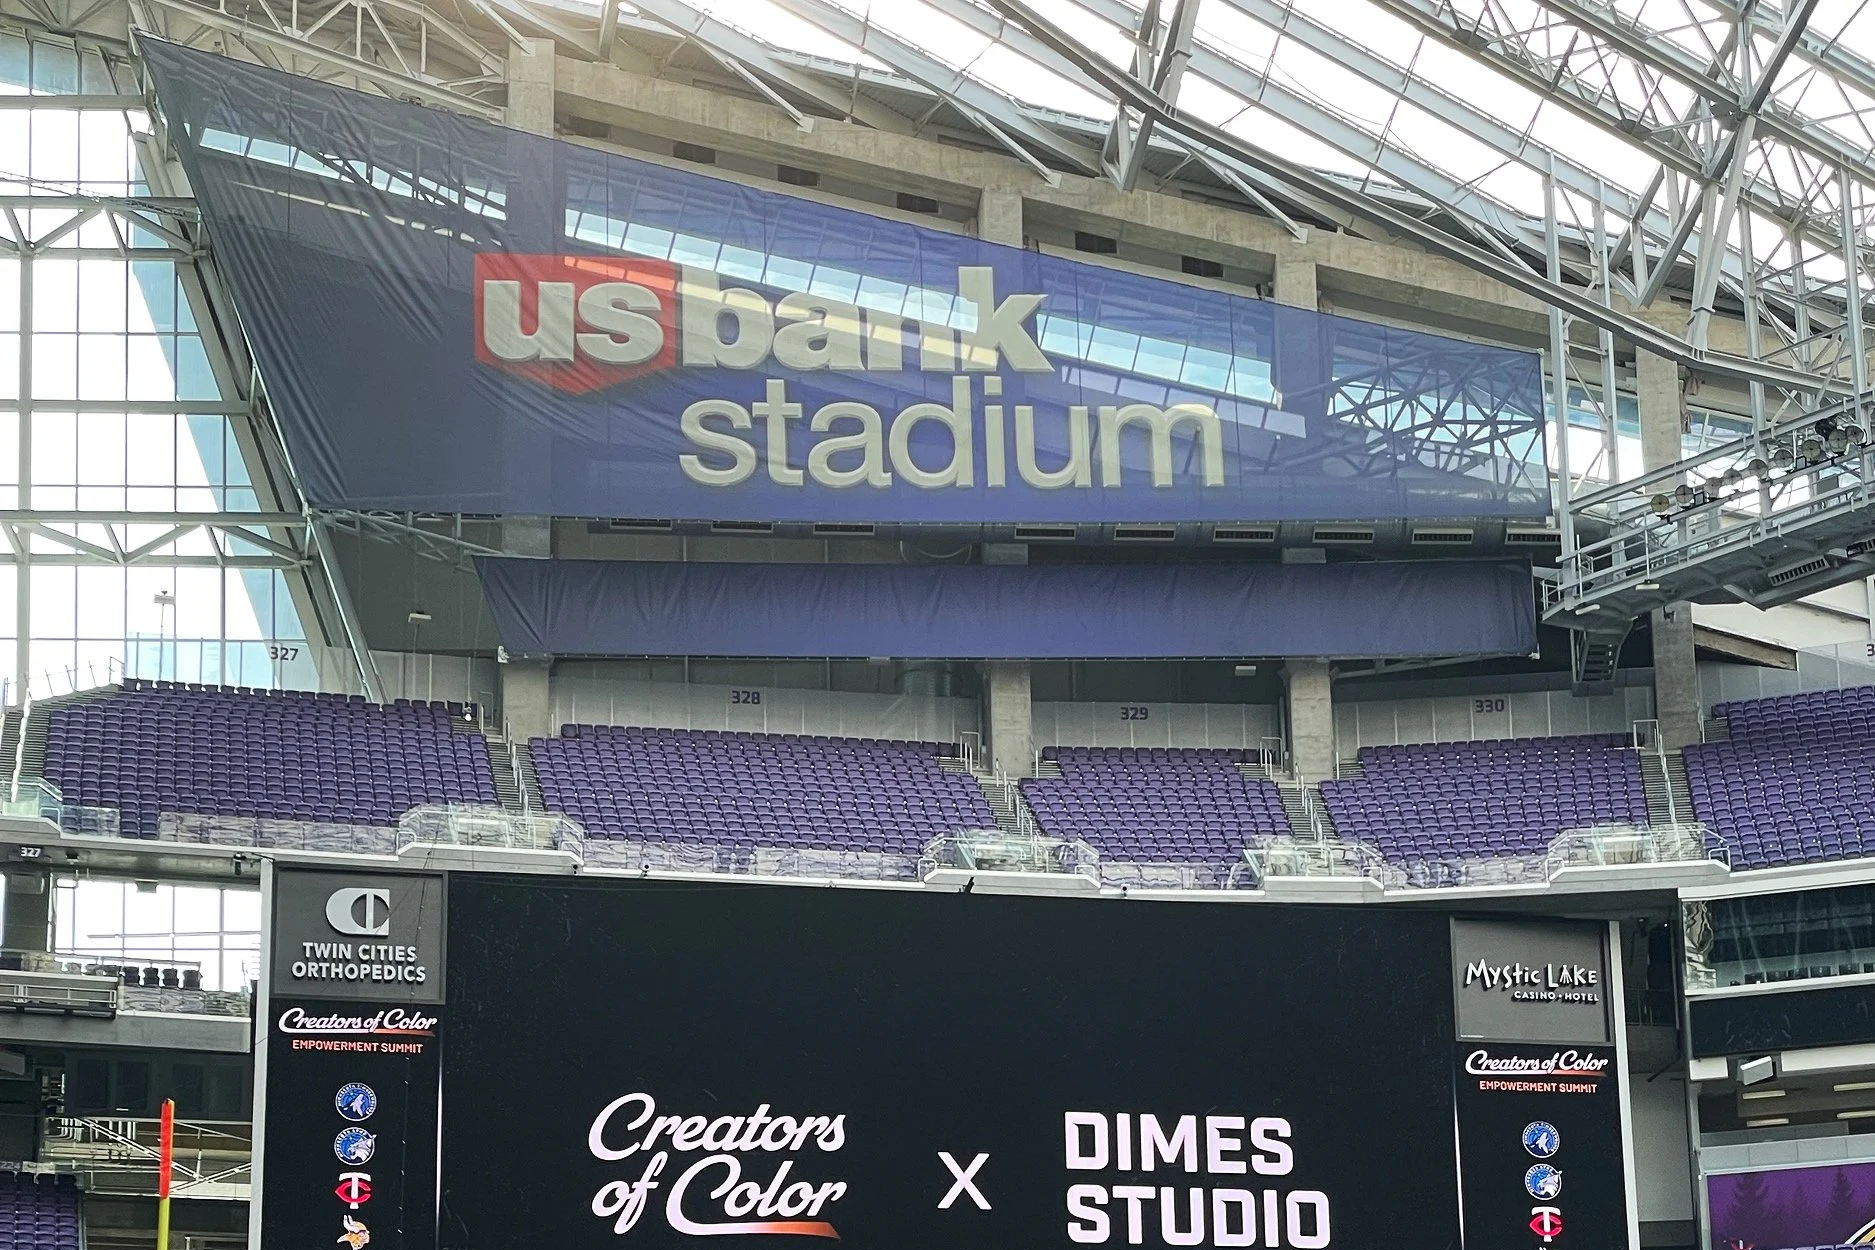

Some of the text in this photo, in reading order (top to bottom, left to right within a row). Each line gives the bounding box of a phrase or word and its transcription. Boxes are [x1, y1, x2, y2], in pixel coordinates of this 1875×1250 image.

[678, 375, 1226, 489] stadium
[269, 646, 299, 662] 327
[731, 690, 761, 705] 328
[1474, 699, 1505, 714] 330
[1119, 706, 1149, 721] 329
[20, 846, 41, 858] 327
[302, 942, 418, 962] TWIN CITIES
[291, 961, 426, 983] ORTHOPEDICS
[1513, 990, 1600, 1001] CASINO HOTEL
[278, 1007, 438, 1034] Creators of Color
[292, 1039, 424, 1054] EMPOWERMENT SUMMIT
[1465, 1050, 1609, 1075] Creators of Color
[1479, 1080, 1598, 1094] EMPOWERMENT SUMMIT
[588, 1092, 847, 1161] Creators
[1064, 1111, 1294, 1176] DIMES
[590, 1150, 847, 1238] of Color
[1066, 1183, 1331, 1250] STUDIO
